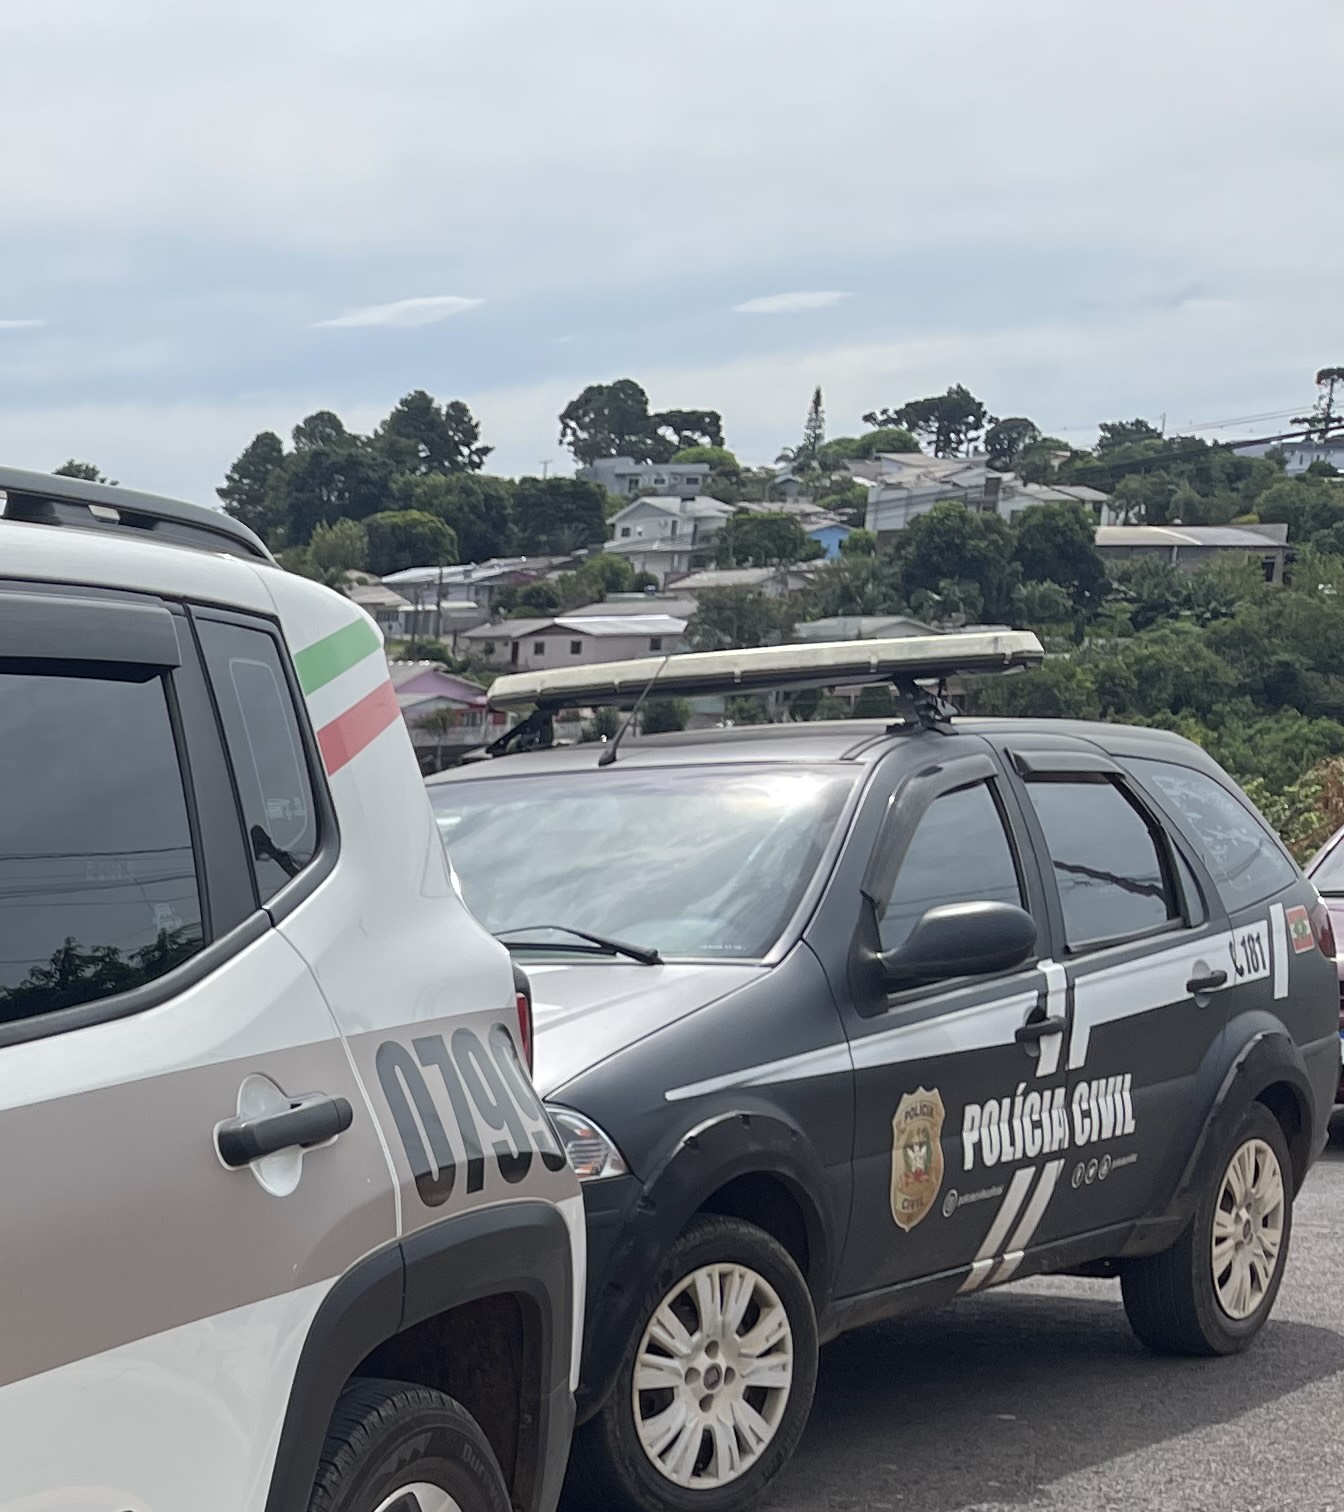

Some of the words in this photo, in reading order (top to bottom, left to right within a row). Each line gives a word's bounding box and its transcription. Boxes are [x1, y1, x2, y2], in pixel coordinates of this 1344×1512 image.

[1241, 932, 1266, 974] 181
[963, 1083, 1069, 1170] POLÍCIA
[1072, 1073, 1135, 1146] CIVIL
